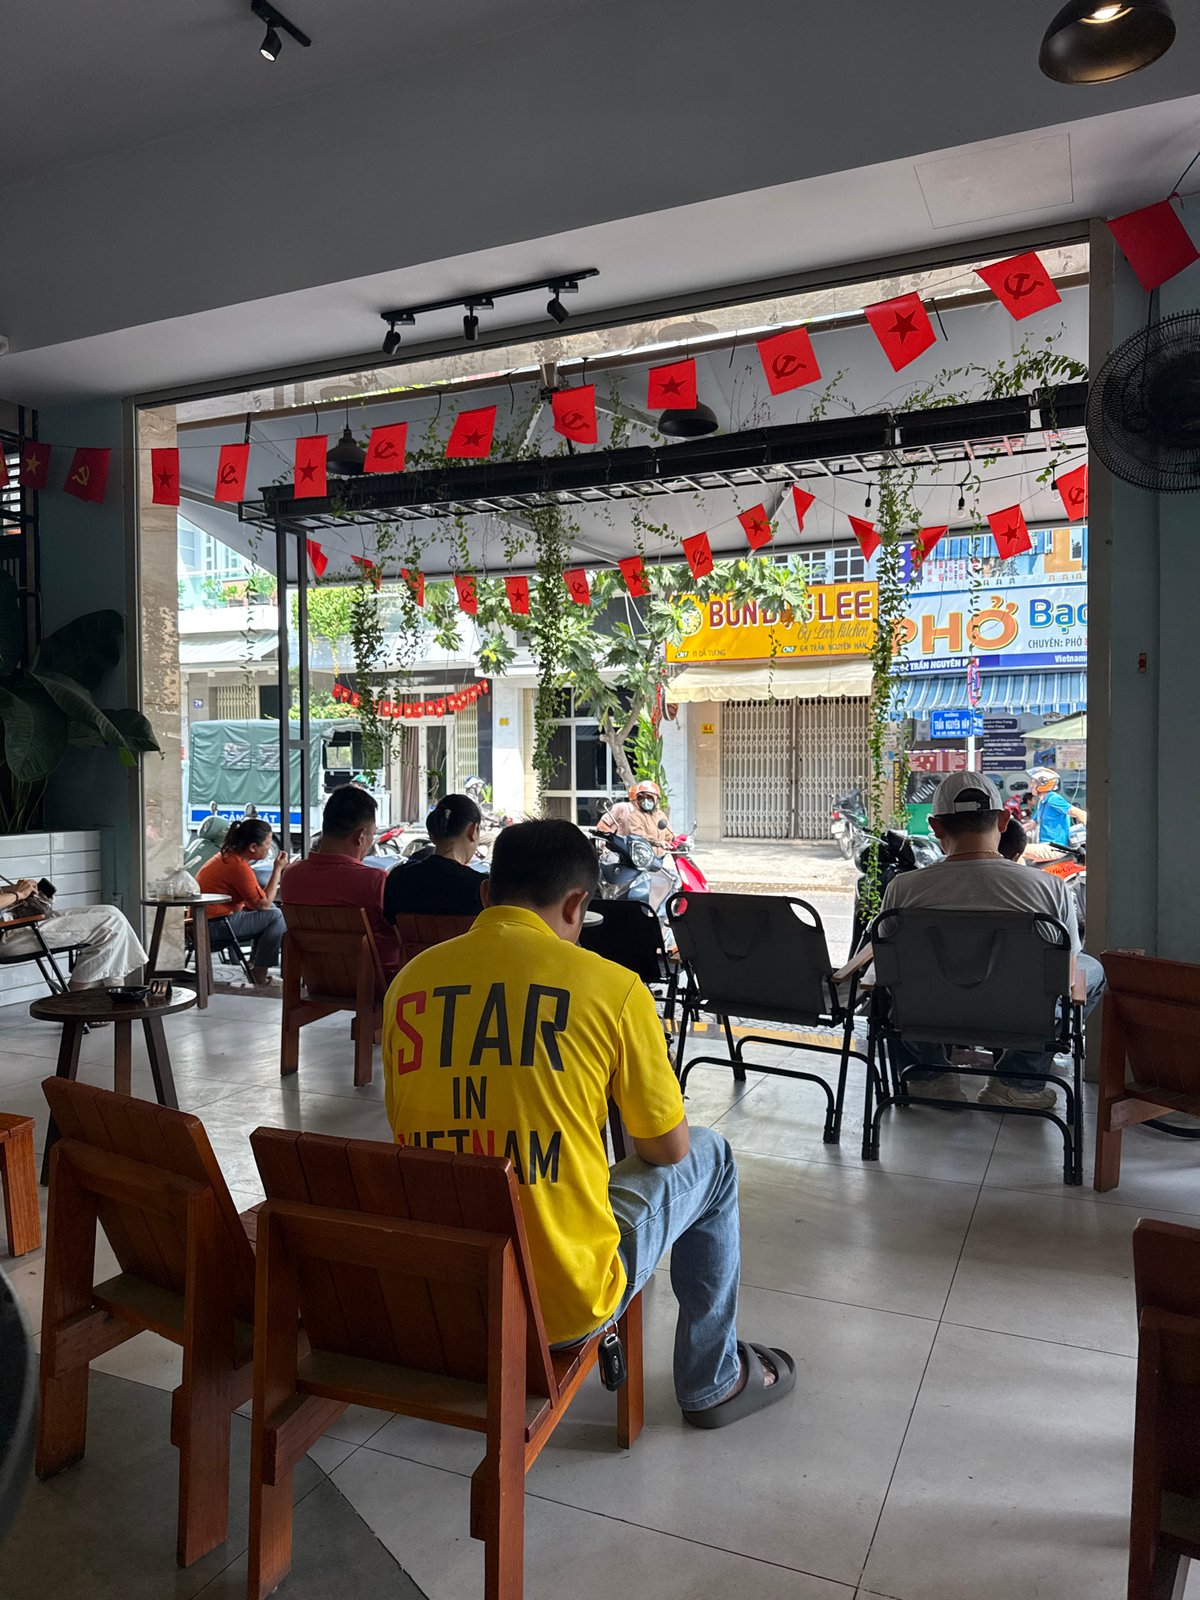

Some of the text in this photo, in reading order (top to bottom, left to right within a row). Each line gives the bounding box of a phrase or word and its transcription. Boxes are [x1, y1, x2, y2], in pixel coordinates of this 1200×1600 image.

[888, 595, 1018, 657] PHỞ
[1065, 634, 1083, 647] PHỞ
[930, 658, 960, 669] NGUYÊN
[395, 982, 570, 1076] STAR
[453, 1076, 487, 1119] IN
